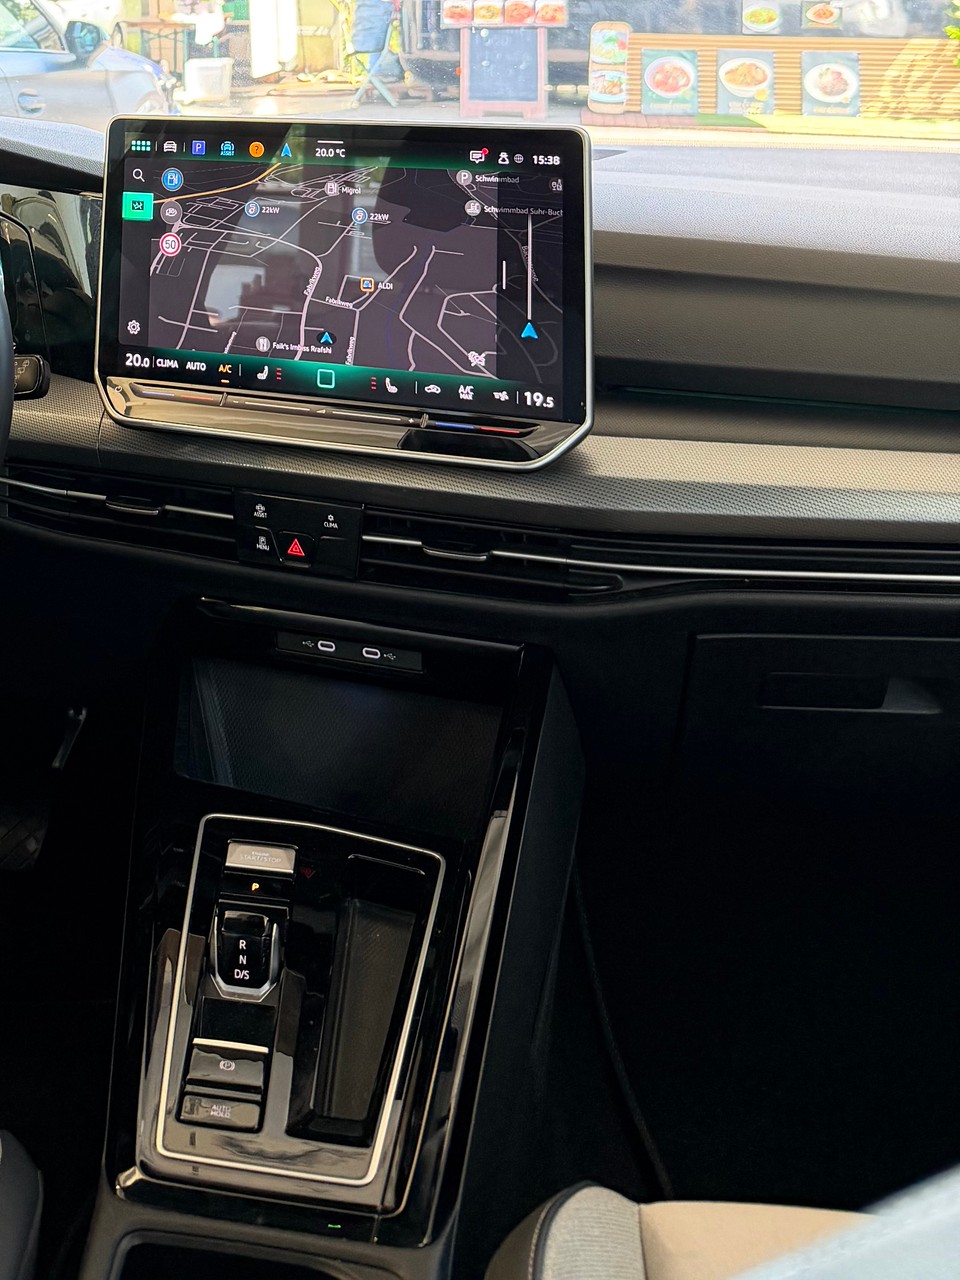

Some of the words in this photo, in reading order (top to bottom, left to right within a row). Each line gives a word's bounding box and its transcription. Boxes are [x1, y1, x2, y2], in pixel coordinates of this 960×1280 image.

[315, 148, 334, 157] 20.0
[336, 148, 345, 157] °C
[533, 155, 560, 165] 15:38
[475, 175, 520, 184] Schwimmbad
[341, 187, 361, 195] Migrol
[261, 206, 280, 214] 22kW
[484, 205, 528, 214] Schwimmbad
[370, 213, 389, 221] 22kW
[165, 239, 176, 250] 50
[303, 266, 321, 296] Fabrikweg
[325, 296, 353, 308] Fabrikweg
[345, 336, 356, 365] Fabrikweg
[126, 353, 150, 368] 20.0
[156, 358, 179, 369] CLIMA
[186, 361, 206, 371] AUTO
[218, 364, 232, 373] A/C
[458, 385, 474, 395] A/C
[524, 392, 555, 408] 19.5
[323, 521, 338, 529] CLIMA
[251, 882, 260, 891] P
[239, 939, 247, 950] R
[239, 954, 247, 965] N
[234, 968, 250, 980] D/S
